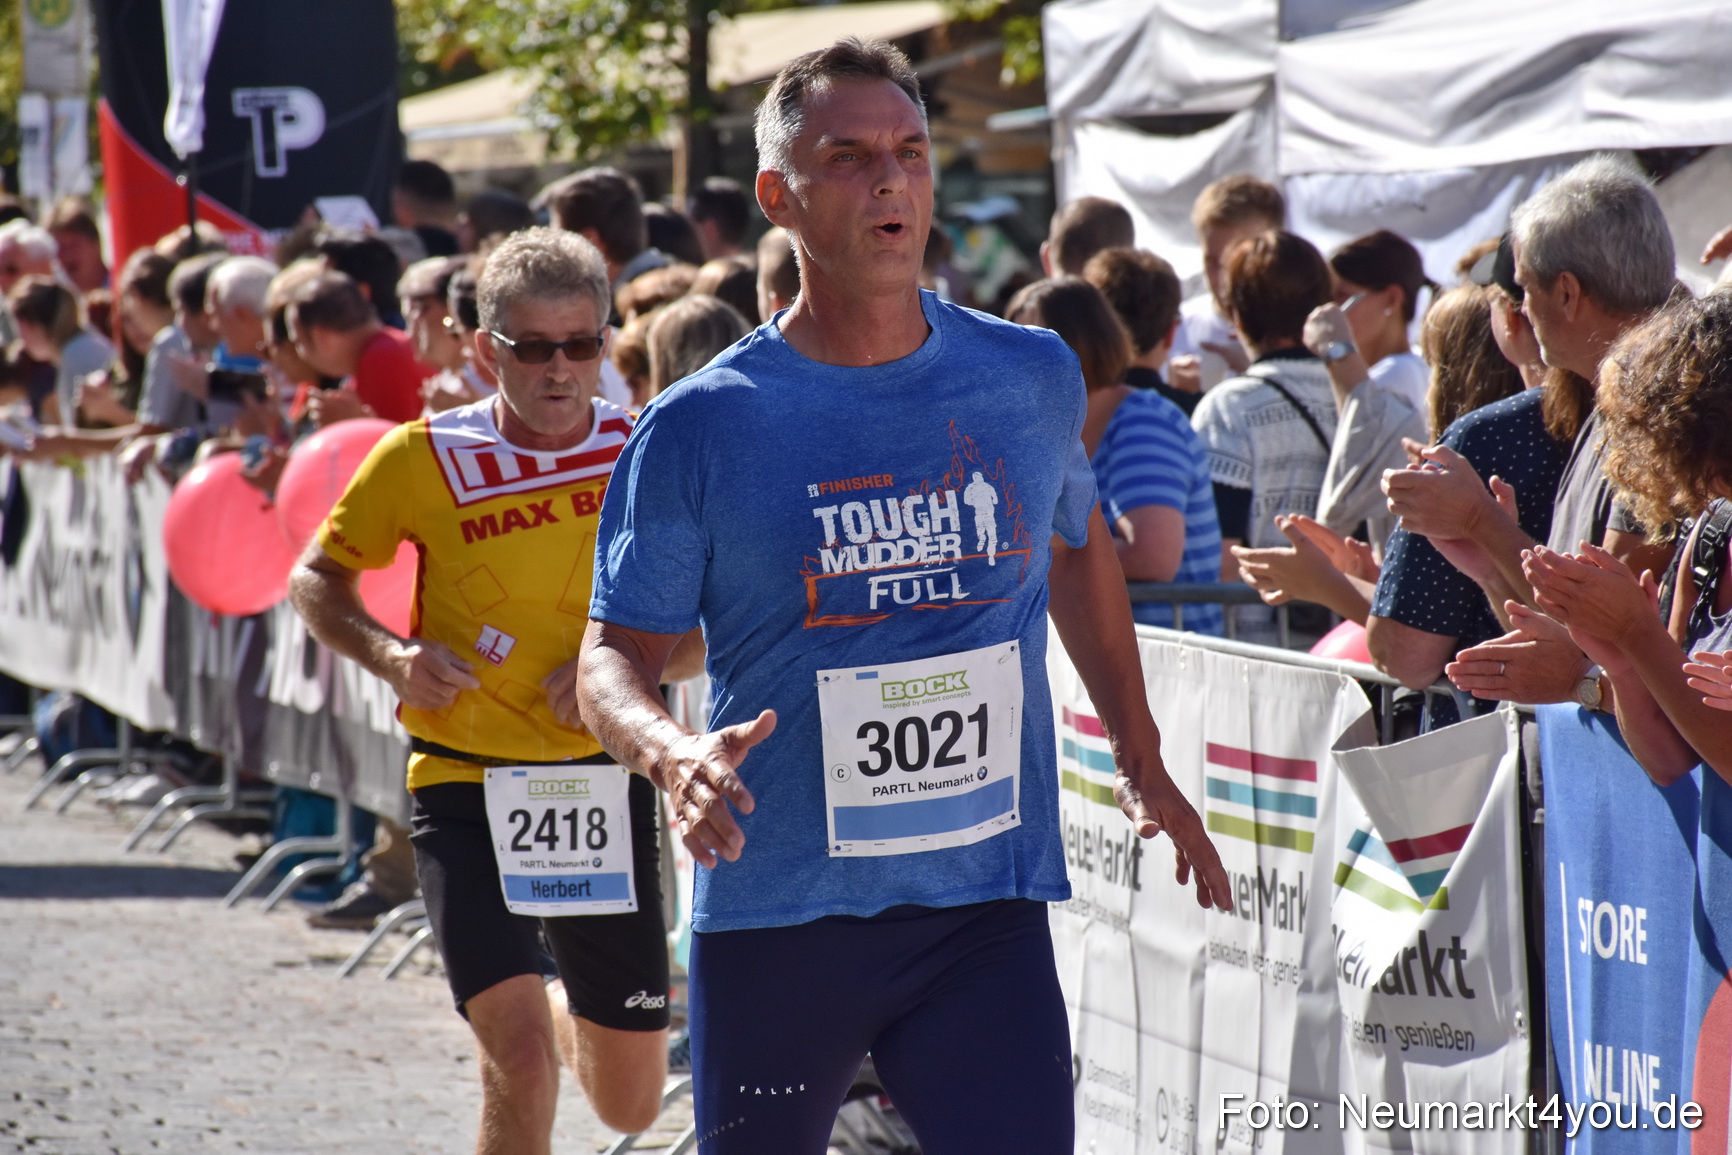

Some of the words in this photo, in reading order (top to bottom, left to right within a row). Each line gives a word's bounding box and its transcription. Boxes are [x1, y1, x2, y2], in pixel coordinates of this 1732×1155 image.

[819, 474, 894, 495] FINISHER
[460, 498, 560, 544] MAX
[813, 490, 961, 547] TOUGH
[818, 533, 962, 575] MUDDER
[867, 567, 970, 610] FULL
[881, 670, 970, 701] BOCK
[882, 701, 911, 709] inspired
[922, 696, 941, 705] smart
[942, 691, 971, 701] concepts
[856, 702, 988, 778] 3021
[528, 779, 590, 795] BOCK
[837, 768, 845, 778] C
[872, 782, 915, 797] PARTL
[918, 773, 974, 791] Neumarkt
[508, 807, 608, 852] 2418
[520, 860, 547, 869] PARTL
[549, 859, 589, 868] Neumarkt
[531, 879, 592, 898] Herbert
[1578, 897, 1647, 965] STORE
[1272, 957, 1298, 987] genie
[1395, 1021, 1475, 1052] genießen
[740, 1084, 805, 1095] FALKE
